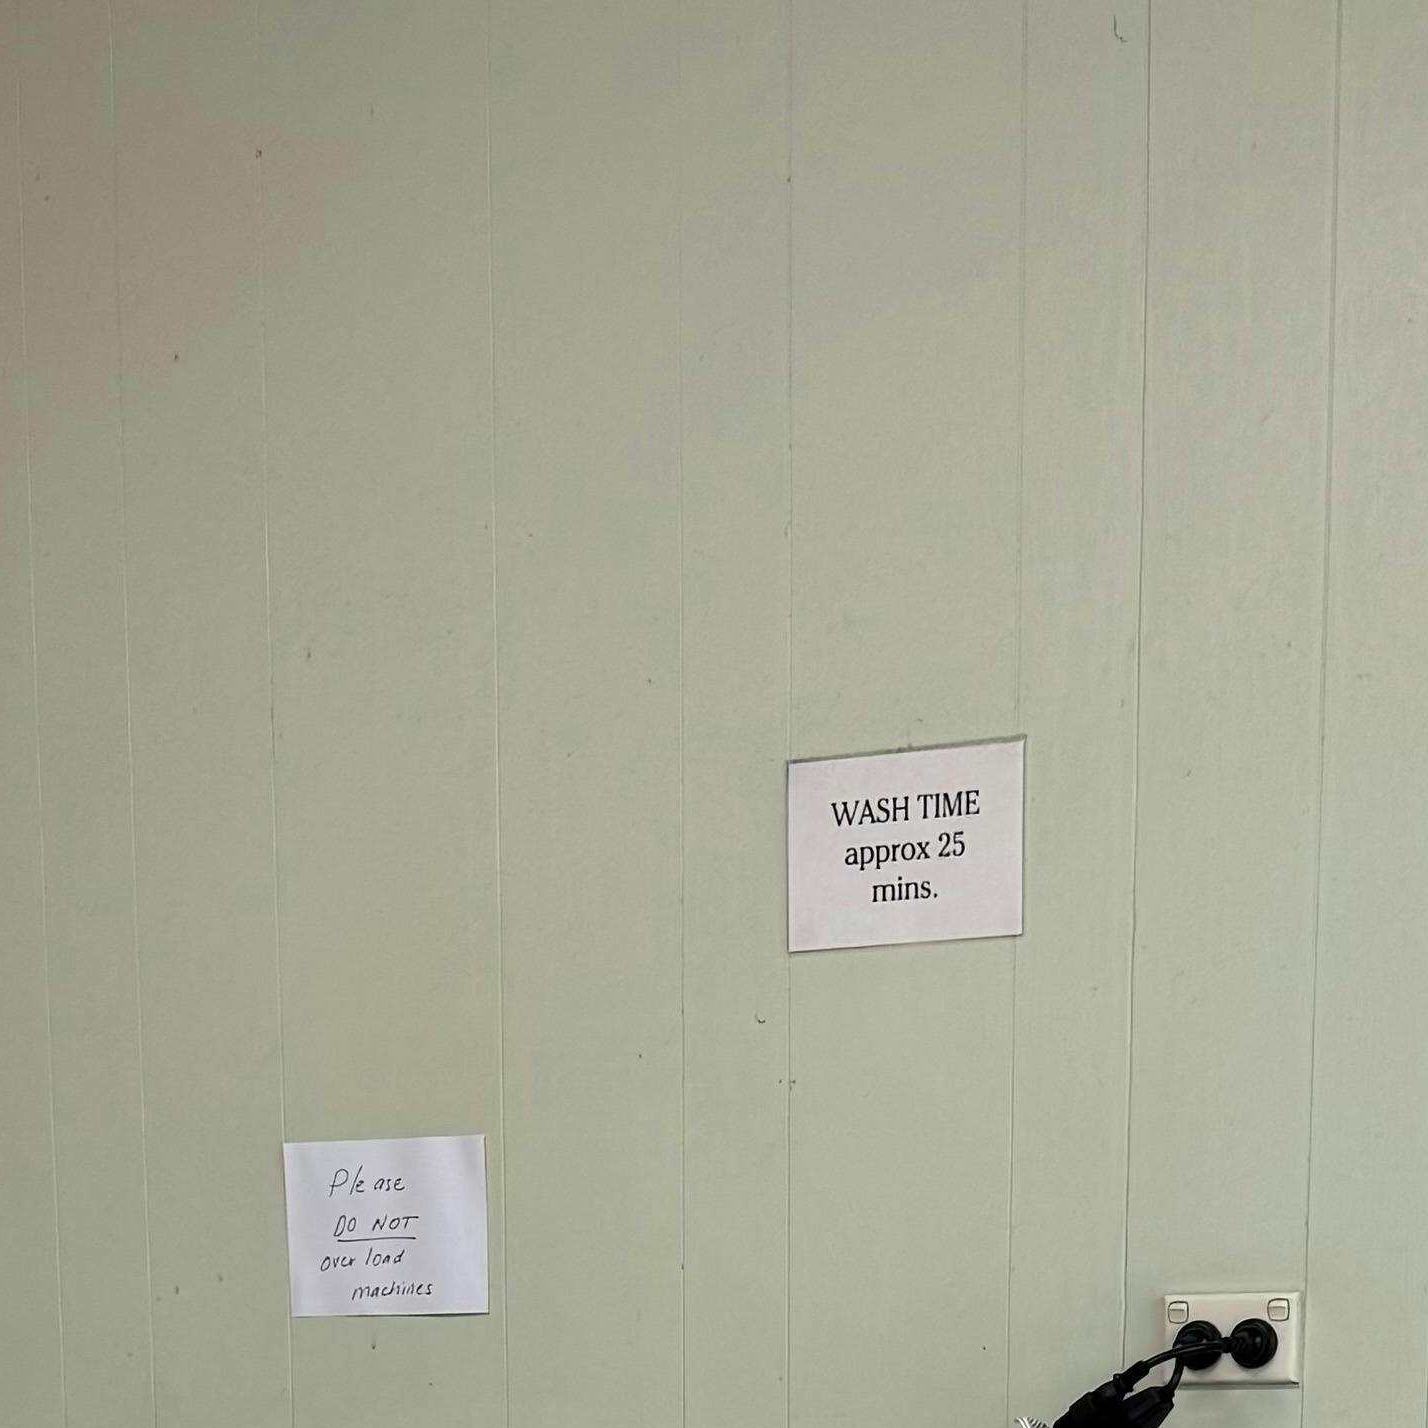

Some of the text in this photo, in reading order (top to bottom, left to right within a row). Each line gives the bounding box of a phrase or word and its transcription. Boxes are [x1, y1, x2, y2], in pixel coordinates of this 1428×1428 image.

[830, 789, 981, 827] WASH TIME
[843, 830, 966, 871] approx 25
[871, 875, 939, 903] mins.
[328, 1164, 406, 1198] Please
[333, 1214, 420, 1237] DO NOT
[320, 1247, 405, 1272] over load
[351, 1279, 434, 1301] machines
